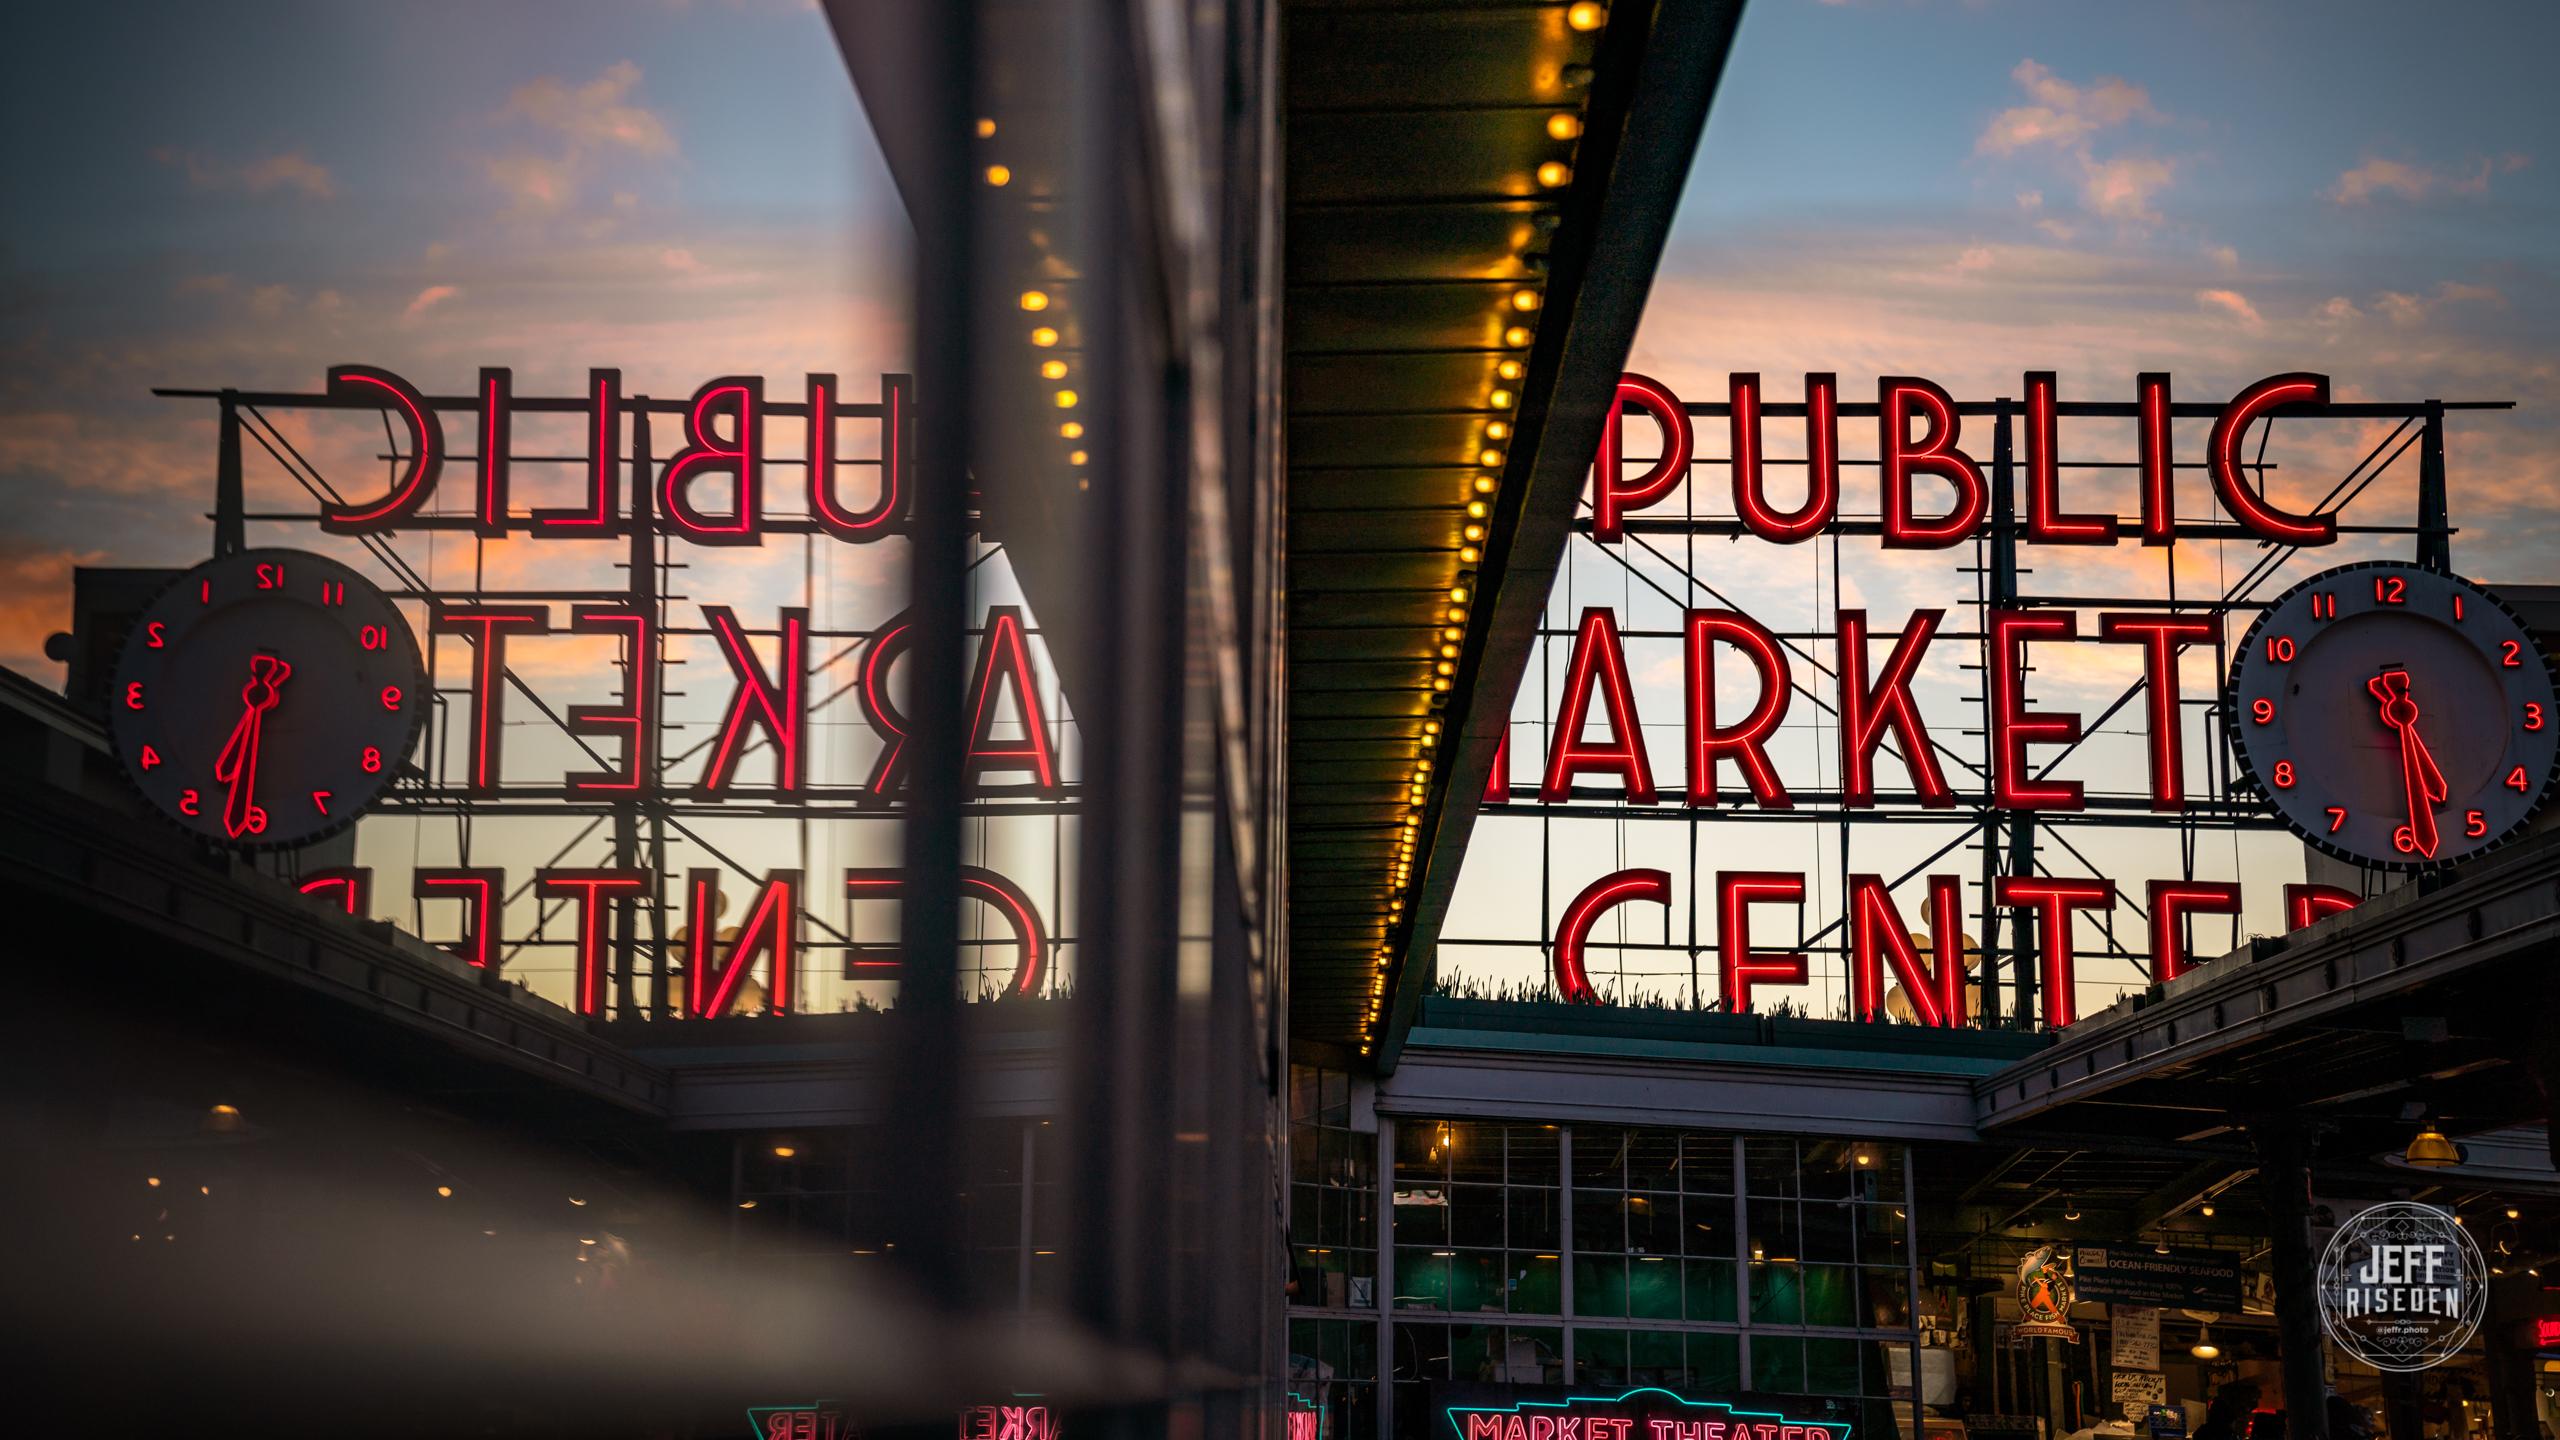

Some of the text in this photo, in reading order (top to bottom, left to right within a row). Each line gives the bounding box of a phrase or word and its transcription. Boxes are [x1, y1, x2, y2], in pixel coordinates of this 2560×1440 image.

[1592, 371, 2338, 550] PUBLIC
[2375, 576, 2406, 604] 12
[2312, 593, 2336, 619] 11
[2454, 595, 2464, 621] 1
[2266, 636, 2297, 663] 10
[2501, 639, 2521, 667] 2
[1482, 605, 2223, 812] ARKET
[2251, 697, 2275, 725] 9
[2524, 701, 2545, 731] 3
[2273, 759, 2297, 789] 8
[2505, 764, 2530, 793] 4
[2326, 806, 2348, 833] 7
[2465, 809, 2488, 838] 5
[2392, 825, 2414, 855] 6
[1552, 867, 2368, 1030] CENT
[2109, 1259, 2187, 1274] OCEAN-FRIENDLY
[2189, 1265, 2235, 1279] SEAFOOD
[2017, 1326, 2073, 1336] WORLD FAMOUS
